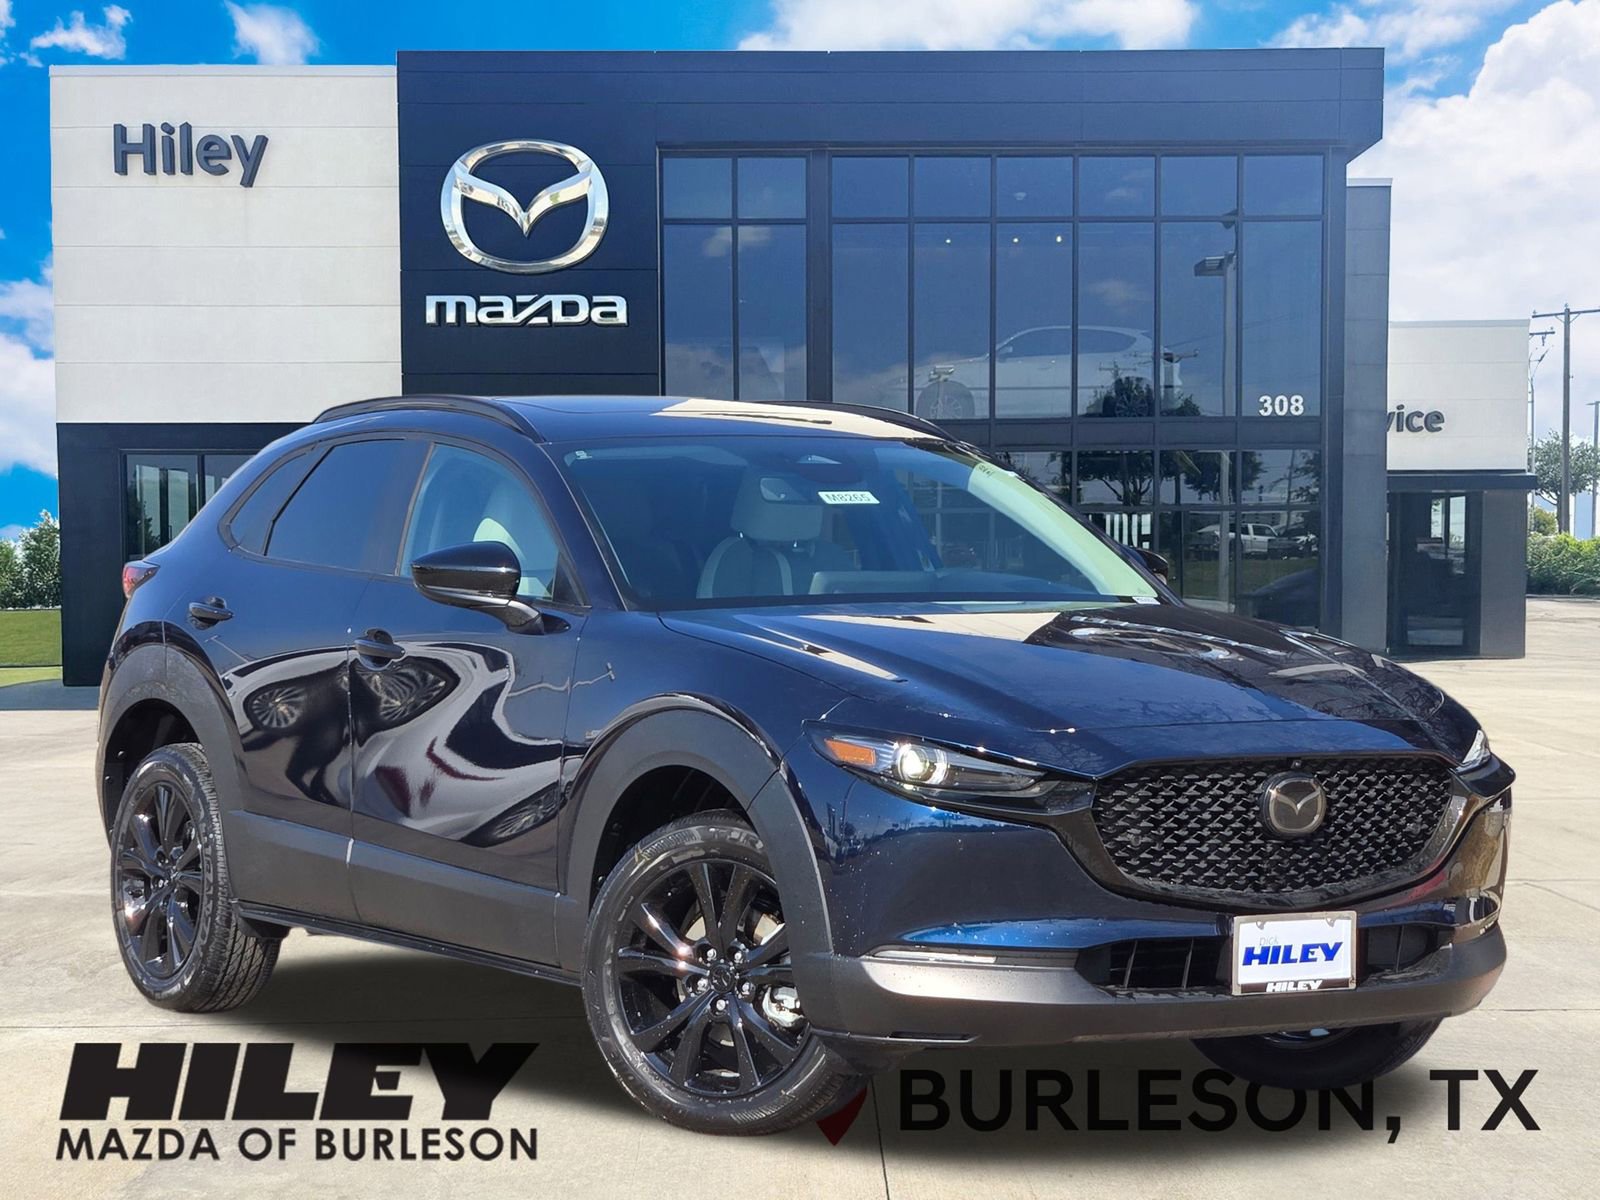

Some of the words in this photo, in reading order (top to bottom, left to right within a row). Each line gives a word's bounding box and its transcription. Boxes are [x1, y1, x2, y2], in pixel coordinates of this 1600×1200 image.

[113, 121, 269, 189] Hiley
[1258, 395, 1304, 416] 308
[1242, 942, 1343, 966] HILEY
[1266, 980, 1322, 992] HILEY
